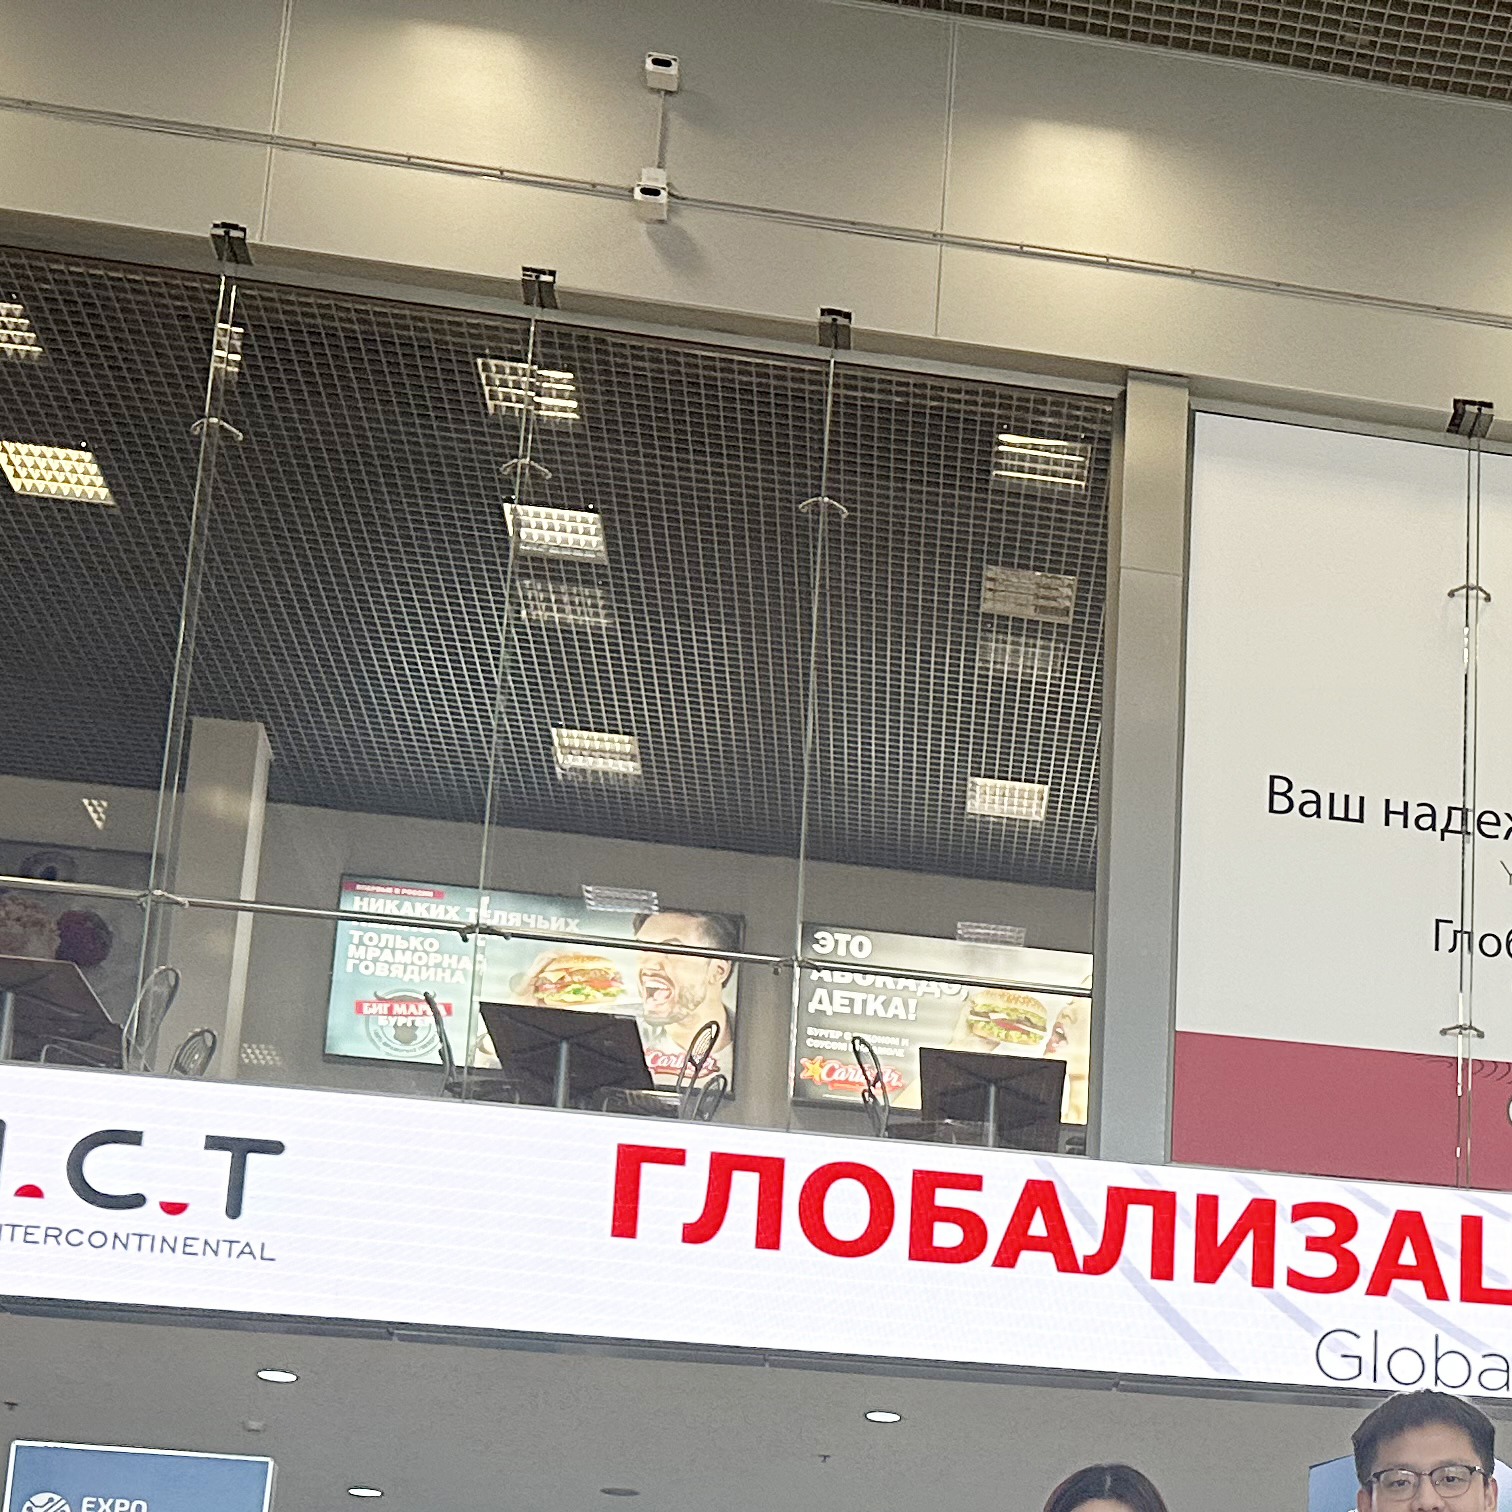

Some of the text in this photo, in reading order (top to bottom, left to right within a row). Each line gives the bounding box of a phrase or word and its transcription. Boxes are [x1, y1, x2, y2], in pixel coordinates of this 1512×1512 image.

[1266, 773, 1365, 827] Ваш
[353, 896, 460, 921] НИКАКИХ
[349, 930, 440, 952] ТОЛЬКО
[812, 931, 872, 959] ЭТО
[346, 959, 466, 985] ГОВЯДИНА
[808, 988, 918, 1021] ДЕТКА!
[0, 1223, 277, 1262] TERCONTINENTAL
